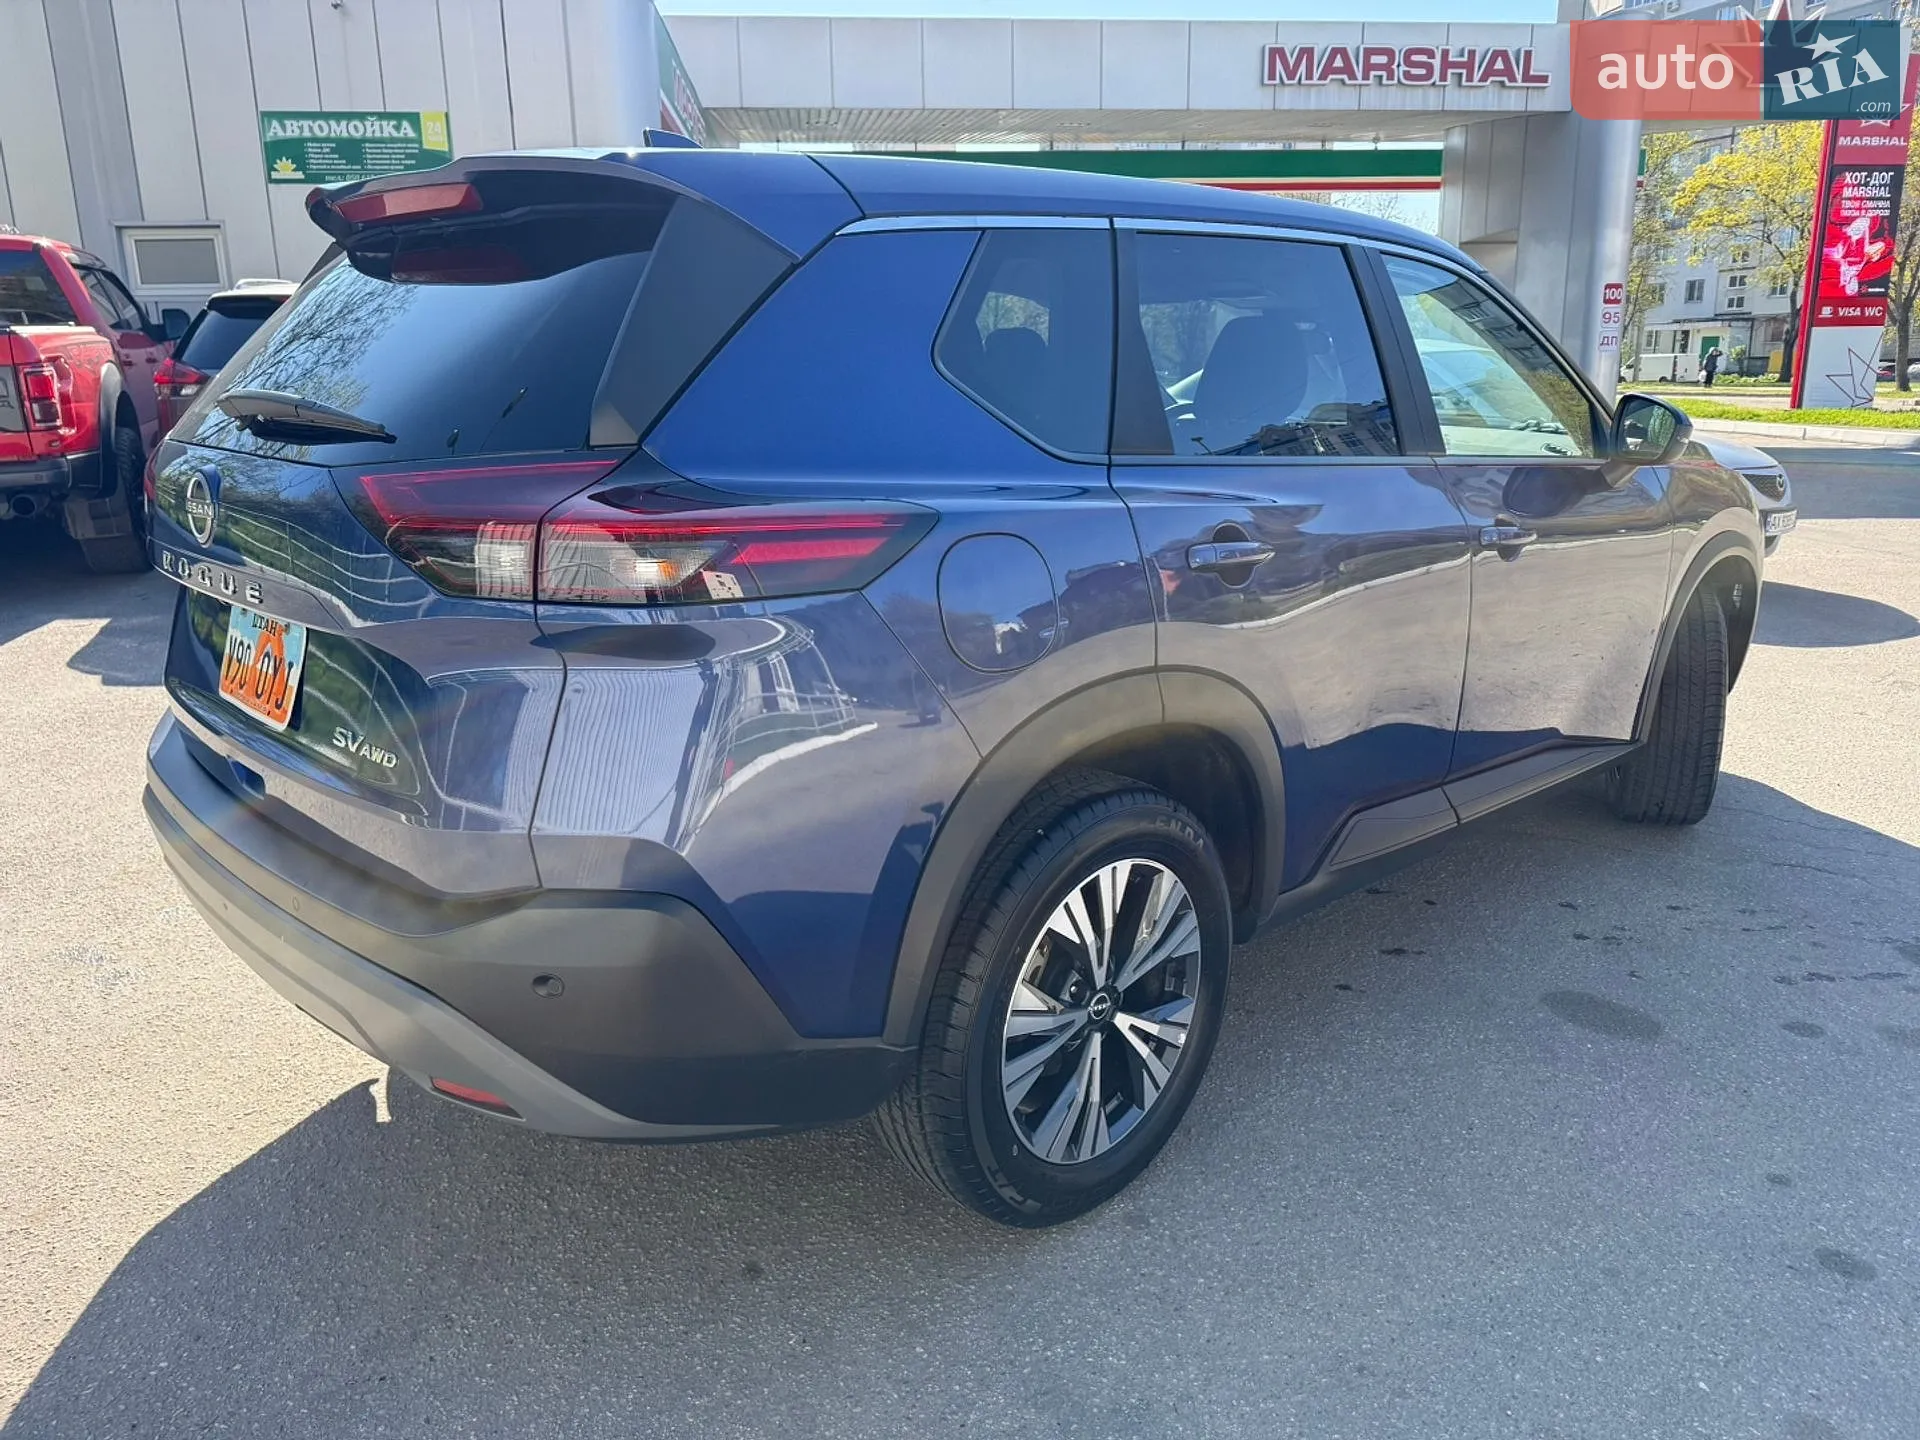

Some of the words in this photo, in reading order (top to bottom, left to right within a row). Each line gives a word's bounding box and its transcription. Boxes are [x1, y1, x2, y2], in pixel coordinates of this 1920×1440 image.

[1262, 44, 1551, 88] MARSHAL
[267, 117, 416, 138] АВТОМОЙКА
[1838, 136, 1907, 146] MARSHAL
[1844, 172, 1894, 186] ХОТ-ДОГ
[1842, 186, 1891, 198] MARSHAL
[1605, 287, 1623, 300] 100
[1602, 311, 1620, 324] 95
[1838, 306, 1861, 317] VISA
[1865, 306, 1883, 317] WC
[1600, 335, 1618, 346] ДП
[162, 550, 264, 604] ROGUE
[251, 613, 278, 637] UTAH
[332, 726, 365, 753] SV
[359, 743, 397, 768] AWD
